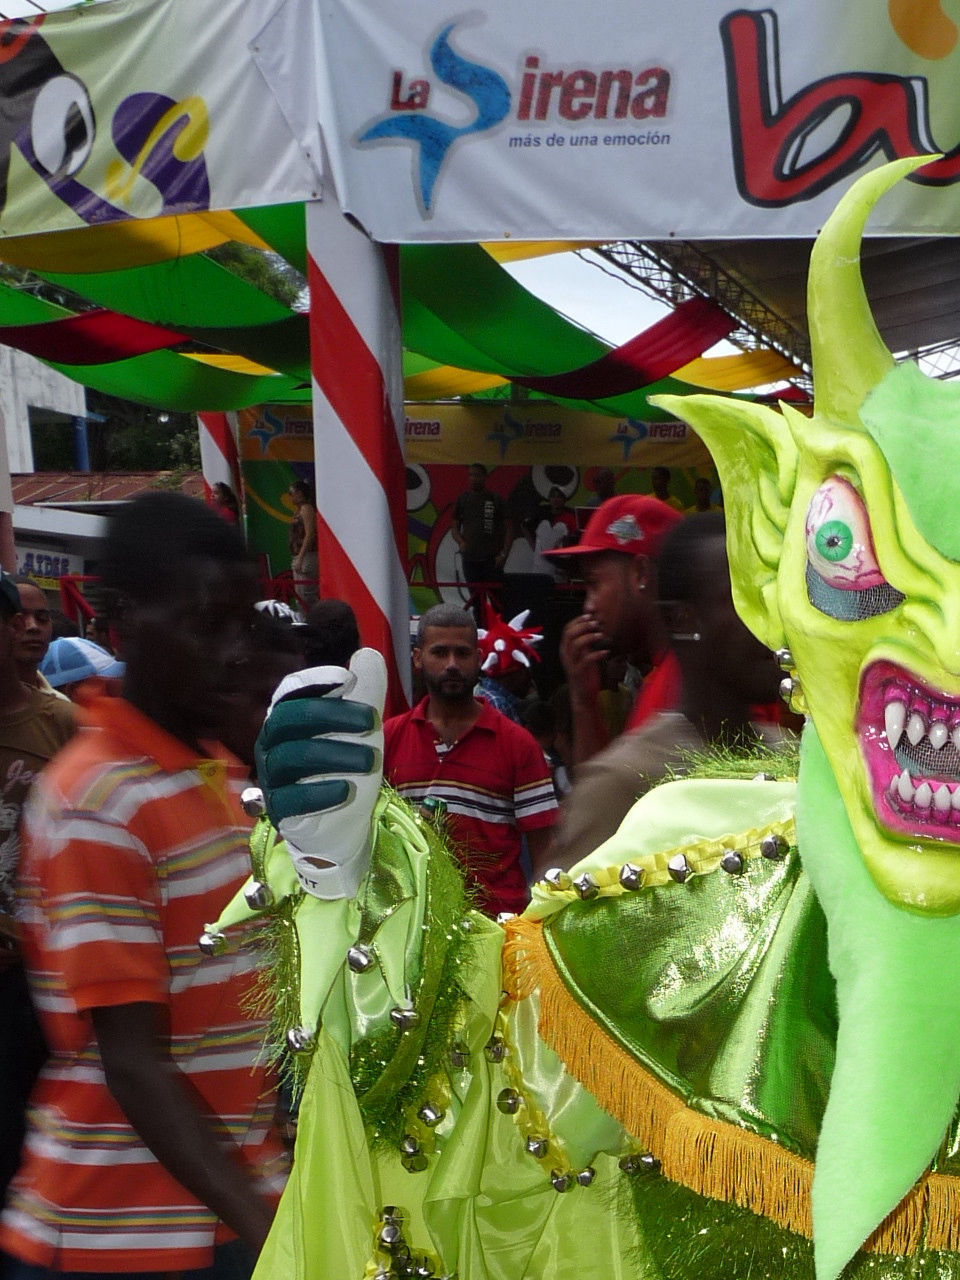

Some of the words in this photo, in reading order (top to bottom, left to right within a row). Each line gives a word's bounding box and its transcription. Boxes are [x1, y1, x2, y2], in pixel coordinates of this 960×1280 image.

[390, 71, 430, 111] La
[508, 133, 541, 148] más
[546, 133, 565, 147] de
[570, 134, 598, 147] una
[603, 131, 671, 146] emoción
